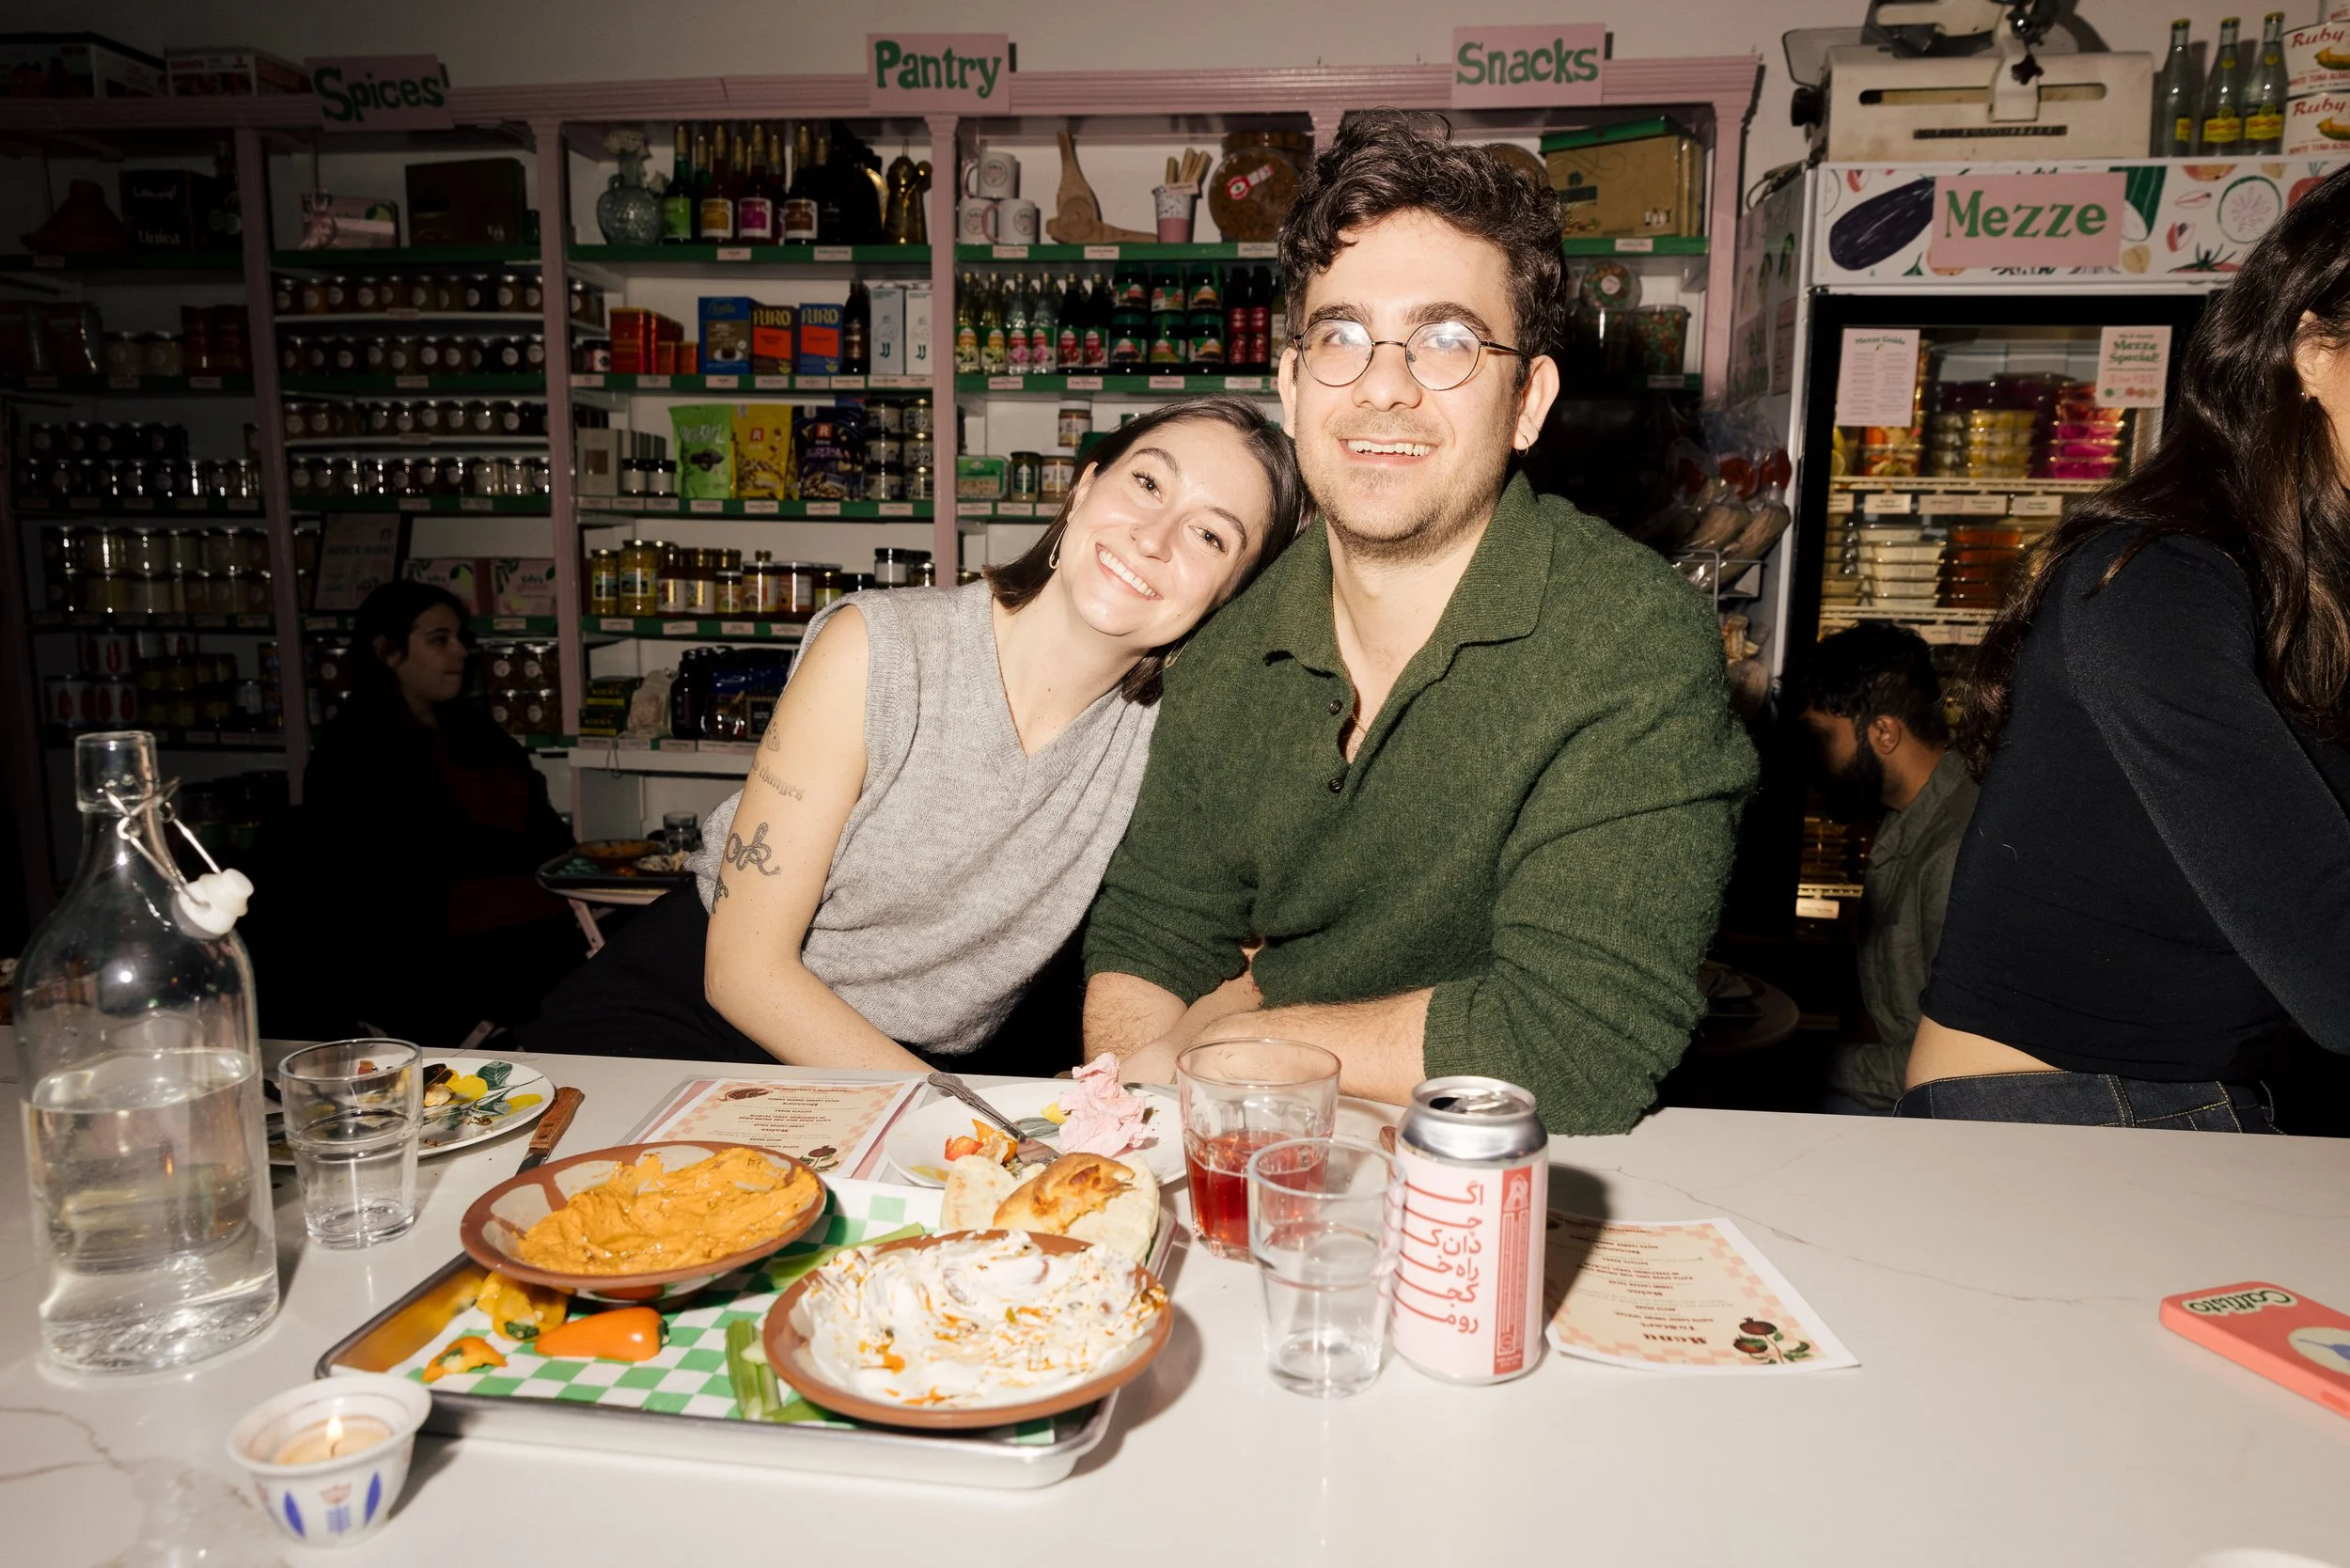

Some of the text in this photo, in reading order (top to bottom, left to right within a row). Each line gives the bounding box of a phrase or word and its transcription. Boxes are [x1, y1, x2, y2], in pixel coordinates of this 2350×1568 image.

[2292, 28, 2344, 48] Ruby
[874, 39, 1002, 98] Pantry
[1456, 38, 1599, 86] Snacks
[314, 68, 444, 121] Spices
[2294, 97, 2346, 117] Ruby
[1945, 190, 2107, 239] Mezze
[753, 308, 791, 326] PURO
[801, 307, 838, 324] PURO
[2113, 340, 2157, 351] Mezze
[2189, 1290, 2291, 1312] Callisto
[1643, 1334, 1707, 1344] Menu
